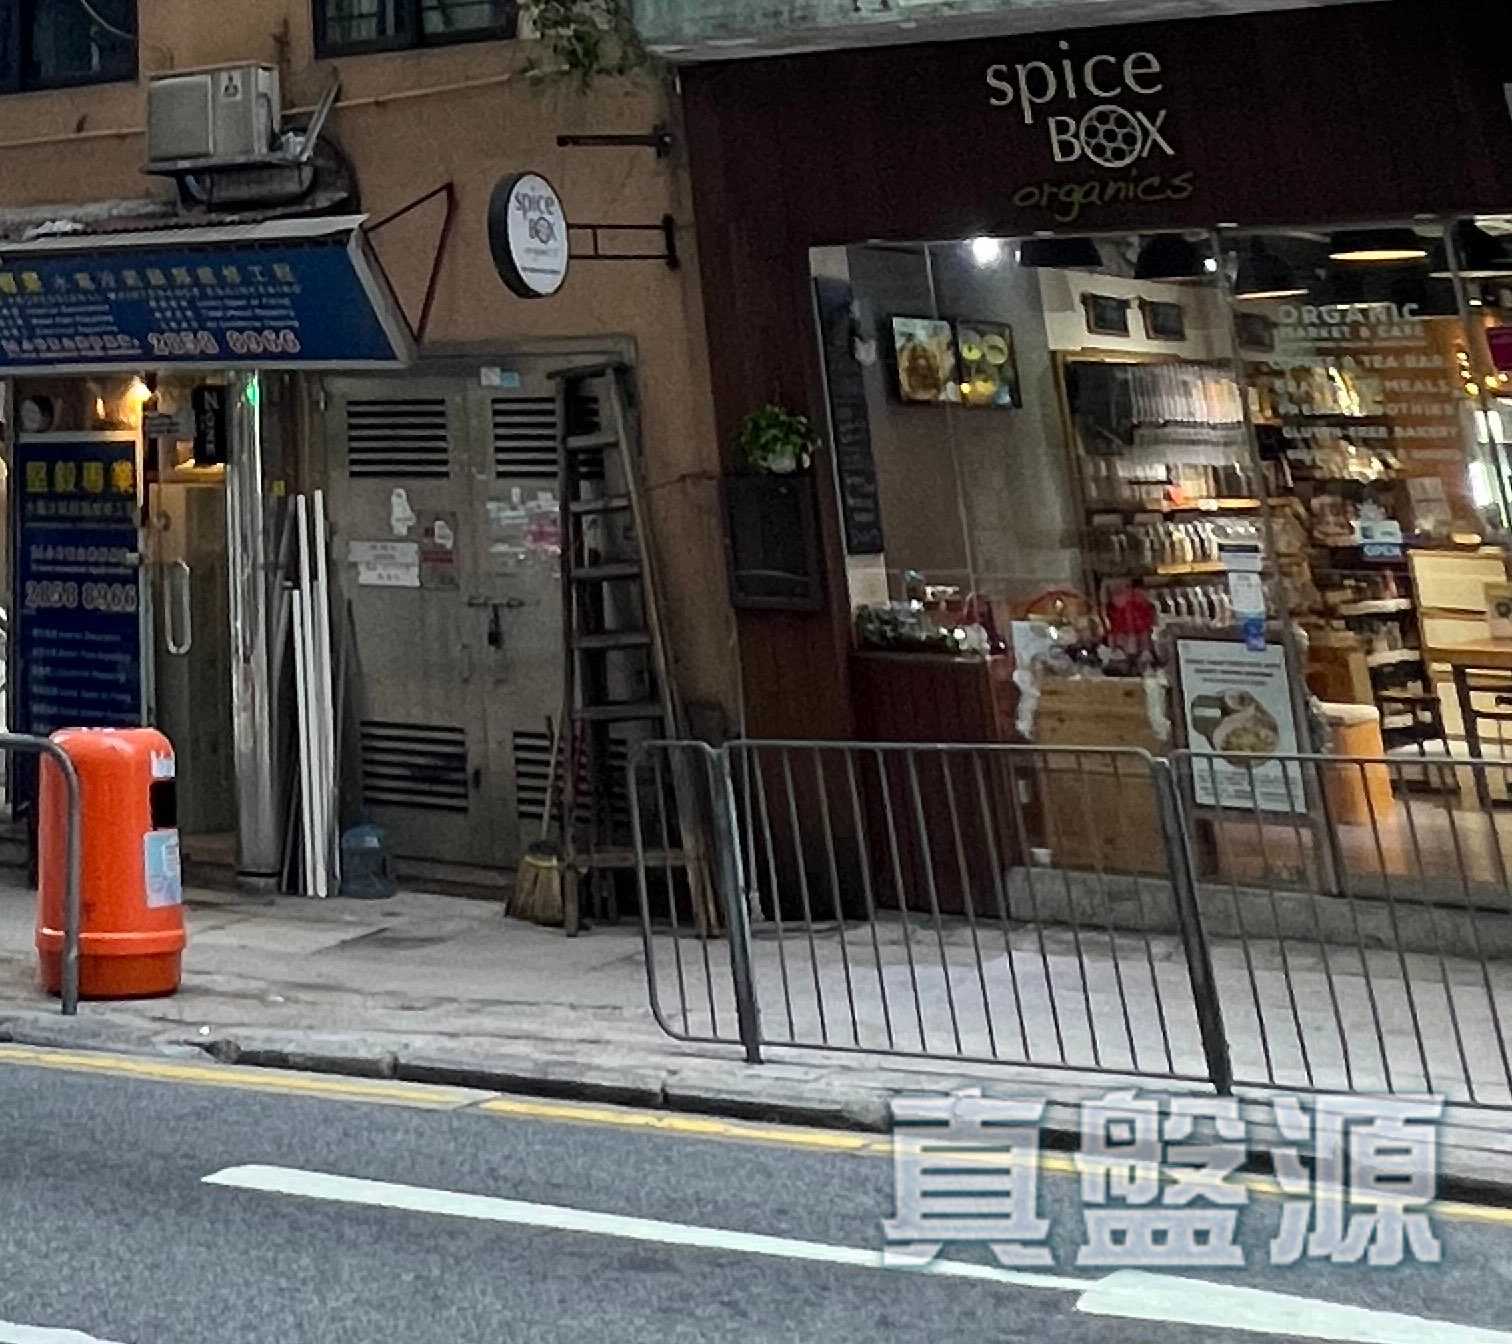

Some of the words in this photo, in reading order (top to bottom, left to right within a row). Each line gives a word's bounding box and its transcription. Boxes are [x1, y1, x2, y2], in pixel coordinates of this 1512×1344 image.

[987, 41, 1162, 123] spice
[1048, 105, 1176, 169] BOX
[514, 184, 555, 220] spice
[1013, 171, 1194, 222] organics
[1277, 302, 1419, 324] ORGANIC
